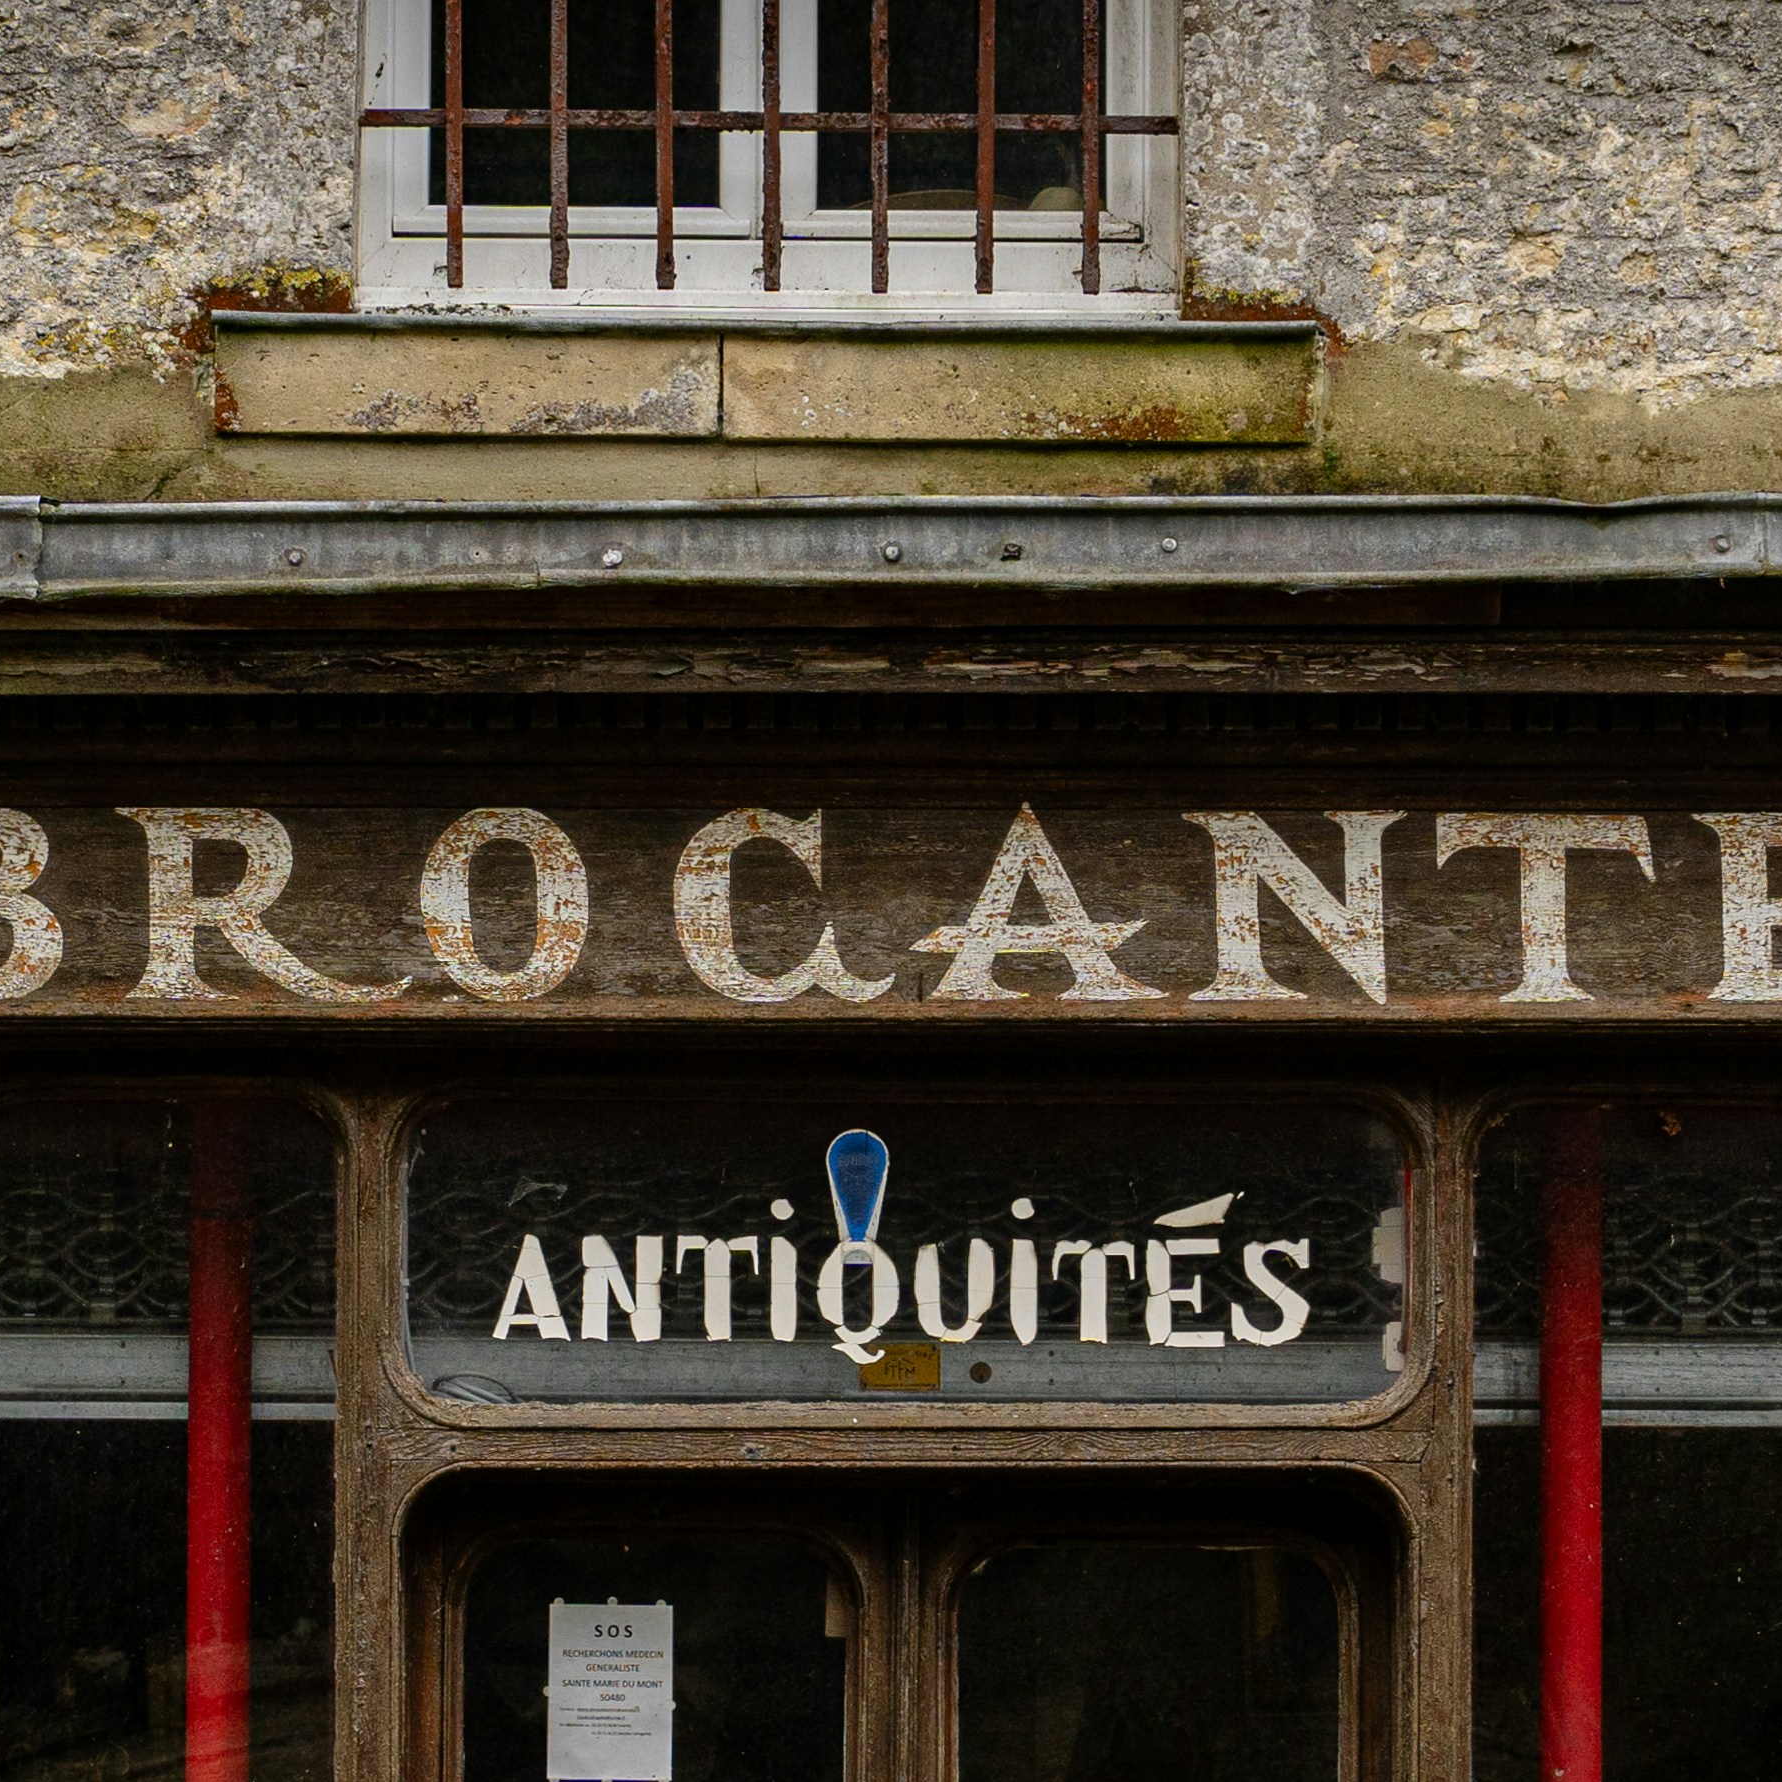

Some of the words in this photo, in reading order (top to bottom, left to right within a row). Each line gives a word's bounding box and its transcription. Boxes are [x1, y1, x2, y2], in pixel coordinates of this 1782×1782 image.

[562, 1649, 624, 1659] RECHERCHONS
[625, 1650, 664, 1659] MEDECIN
[585, 1663, 640, 1672] GENERALISTE
[562, 1679, 591, 1688] SAINTE
[593, 1680, 620, 1688] MARIE
[622, 1680, 635, 1688] DU
[637, 1680, 664, 1689] MONT
[599, 1693, 626, 1702] 50480
